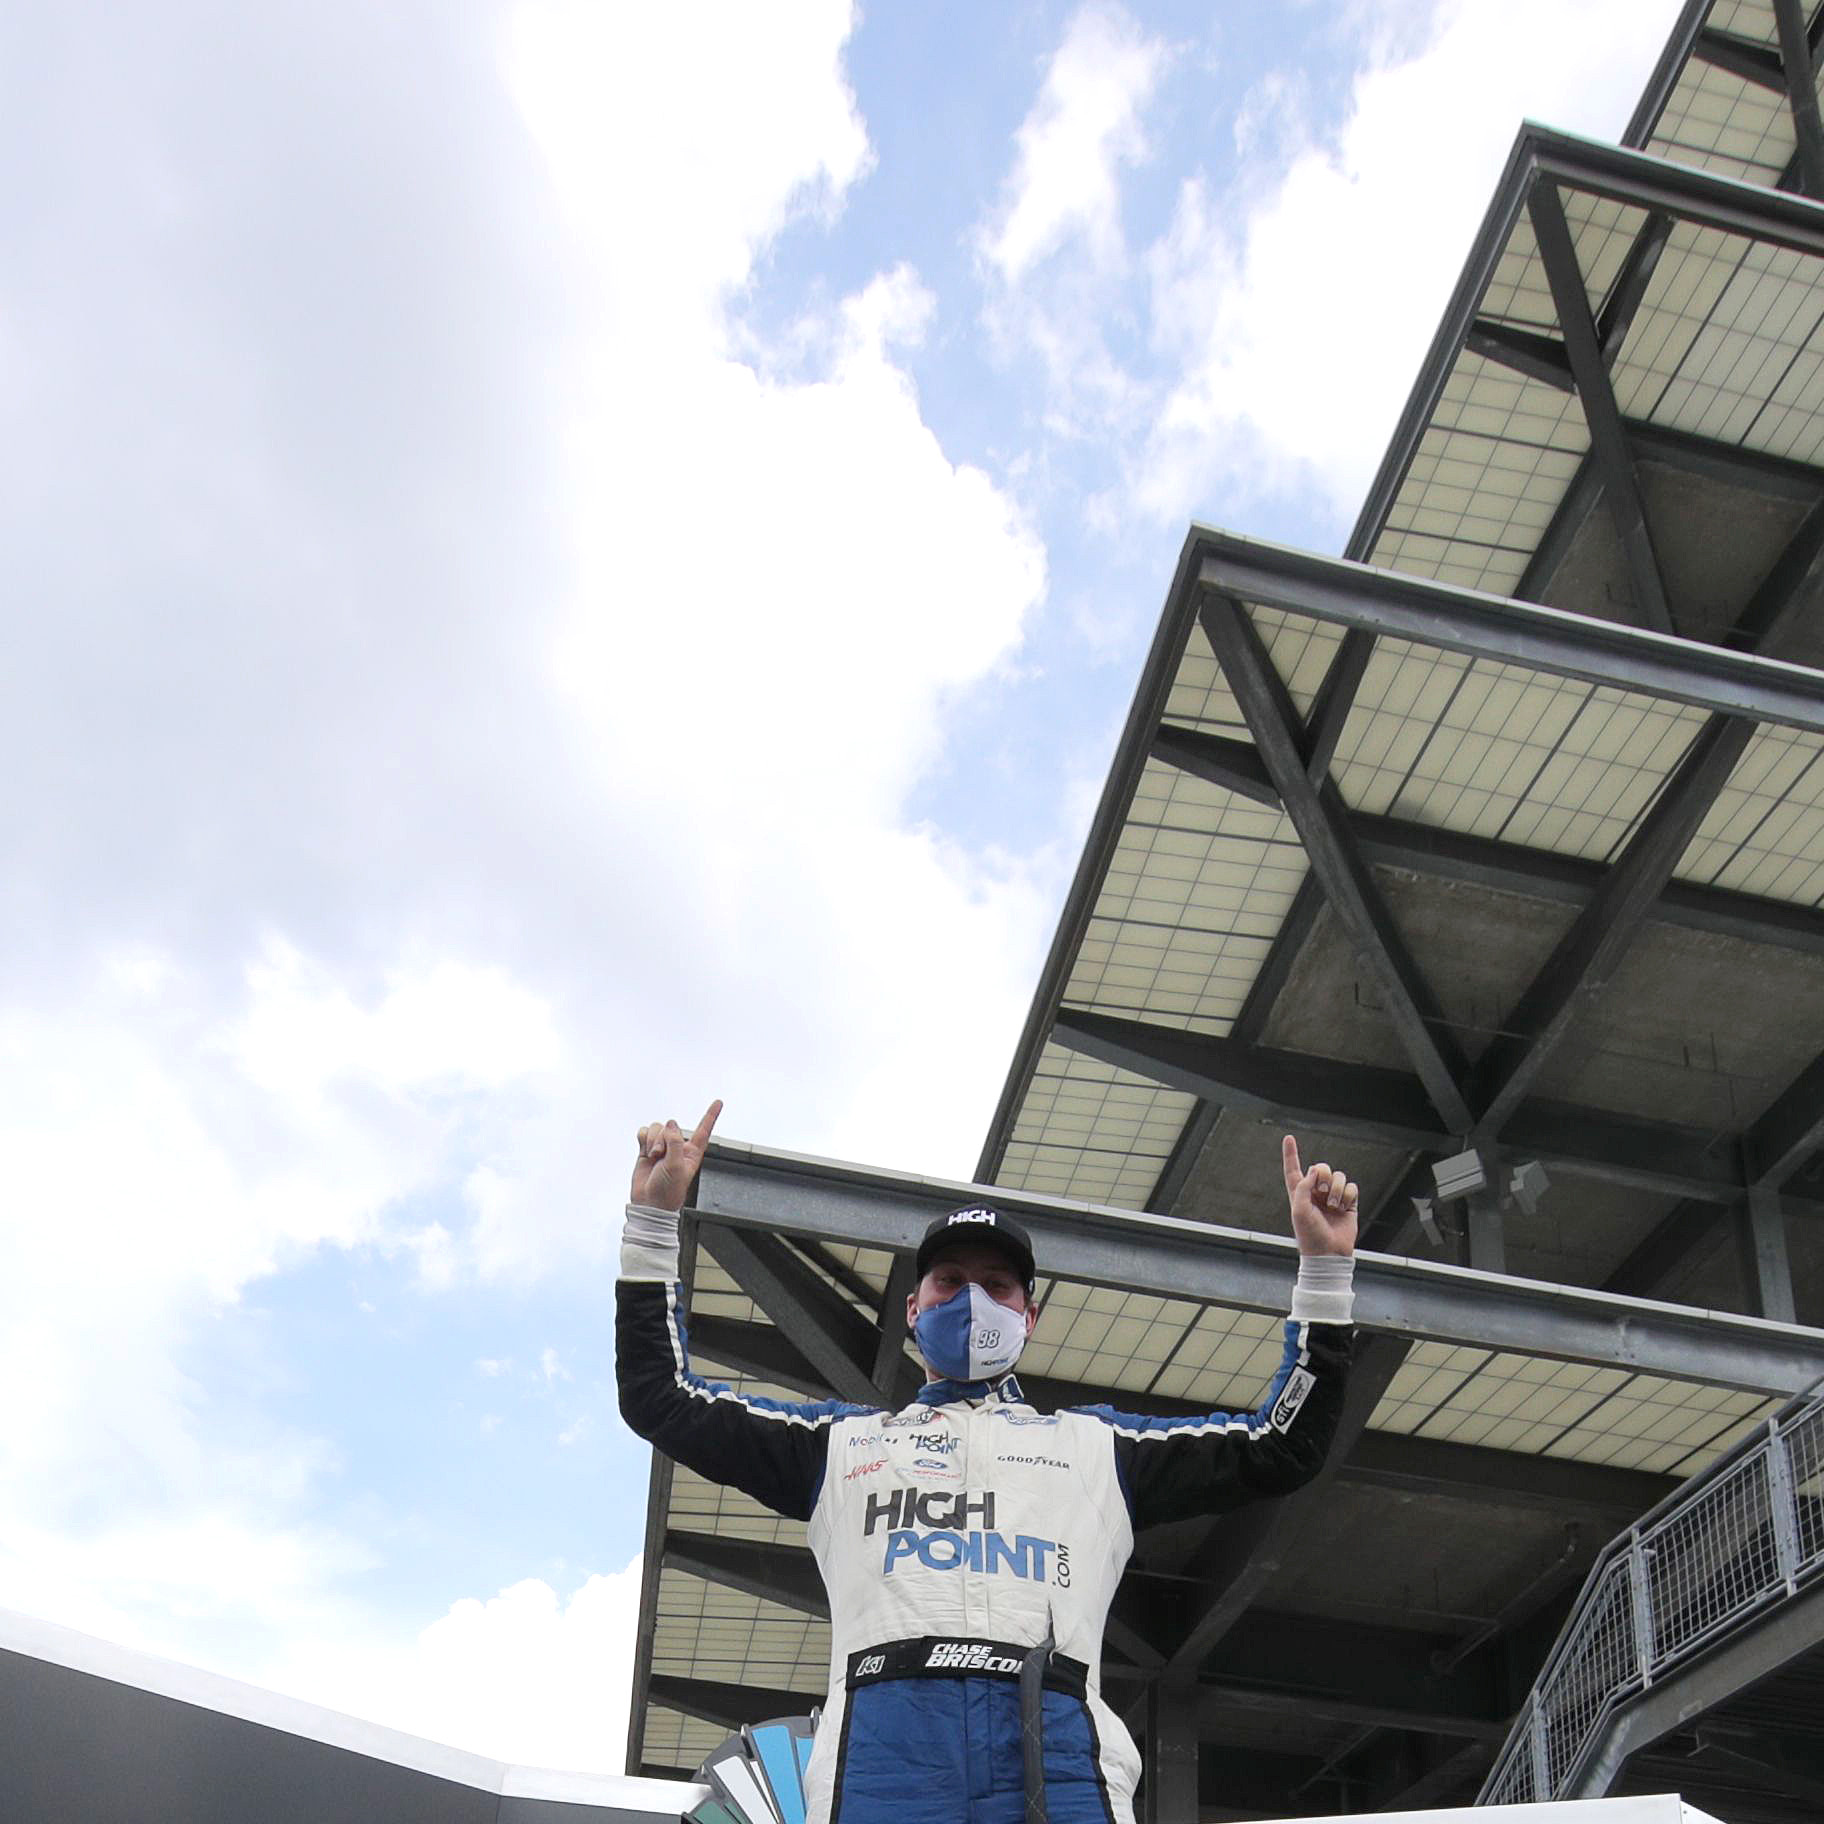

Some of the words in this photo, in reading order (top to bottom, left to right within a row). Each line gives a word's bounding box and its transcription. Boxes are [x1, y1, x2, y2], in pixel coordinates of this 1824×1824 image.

[947, 1210, 996, 1226] HIGH
[977, 1330, 1001, 1349] 98
[997, 1454, 1071, 1470] GOODYEAR
[863, 1486, 996, 1537] HIGH
[883, 1529, 1056, 1583] POINT
[932, 1643, 992, 1657] CHASE
